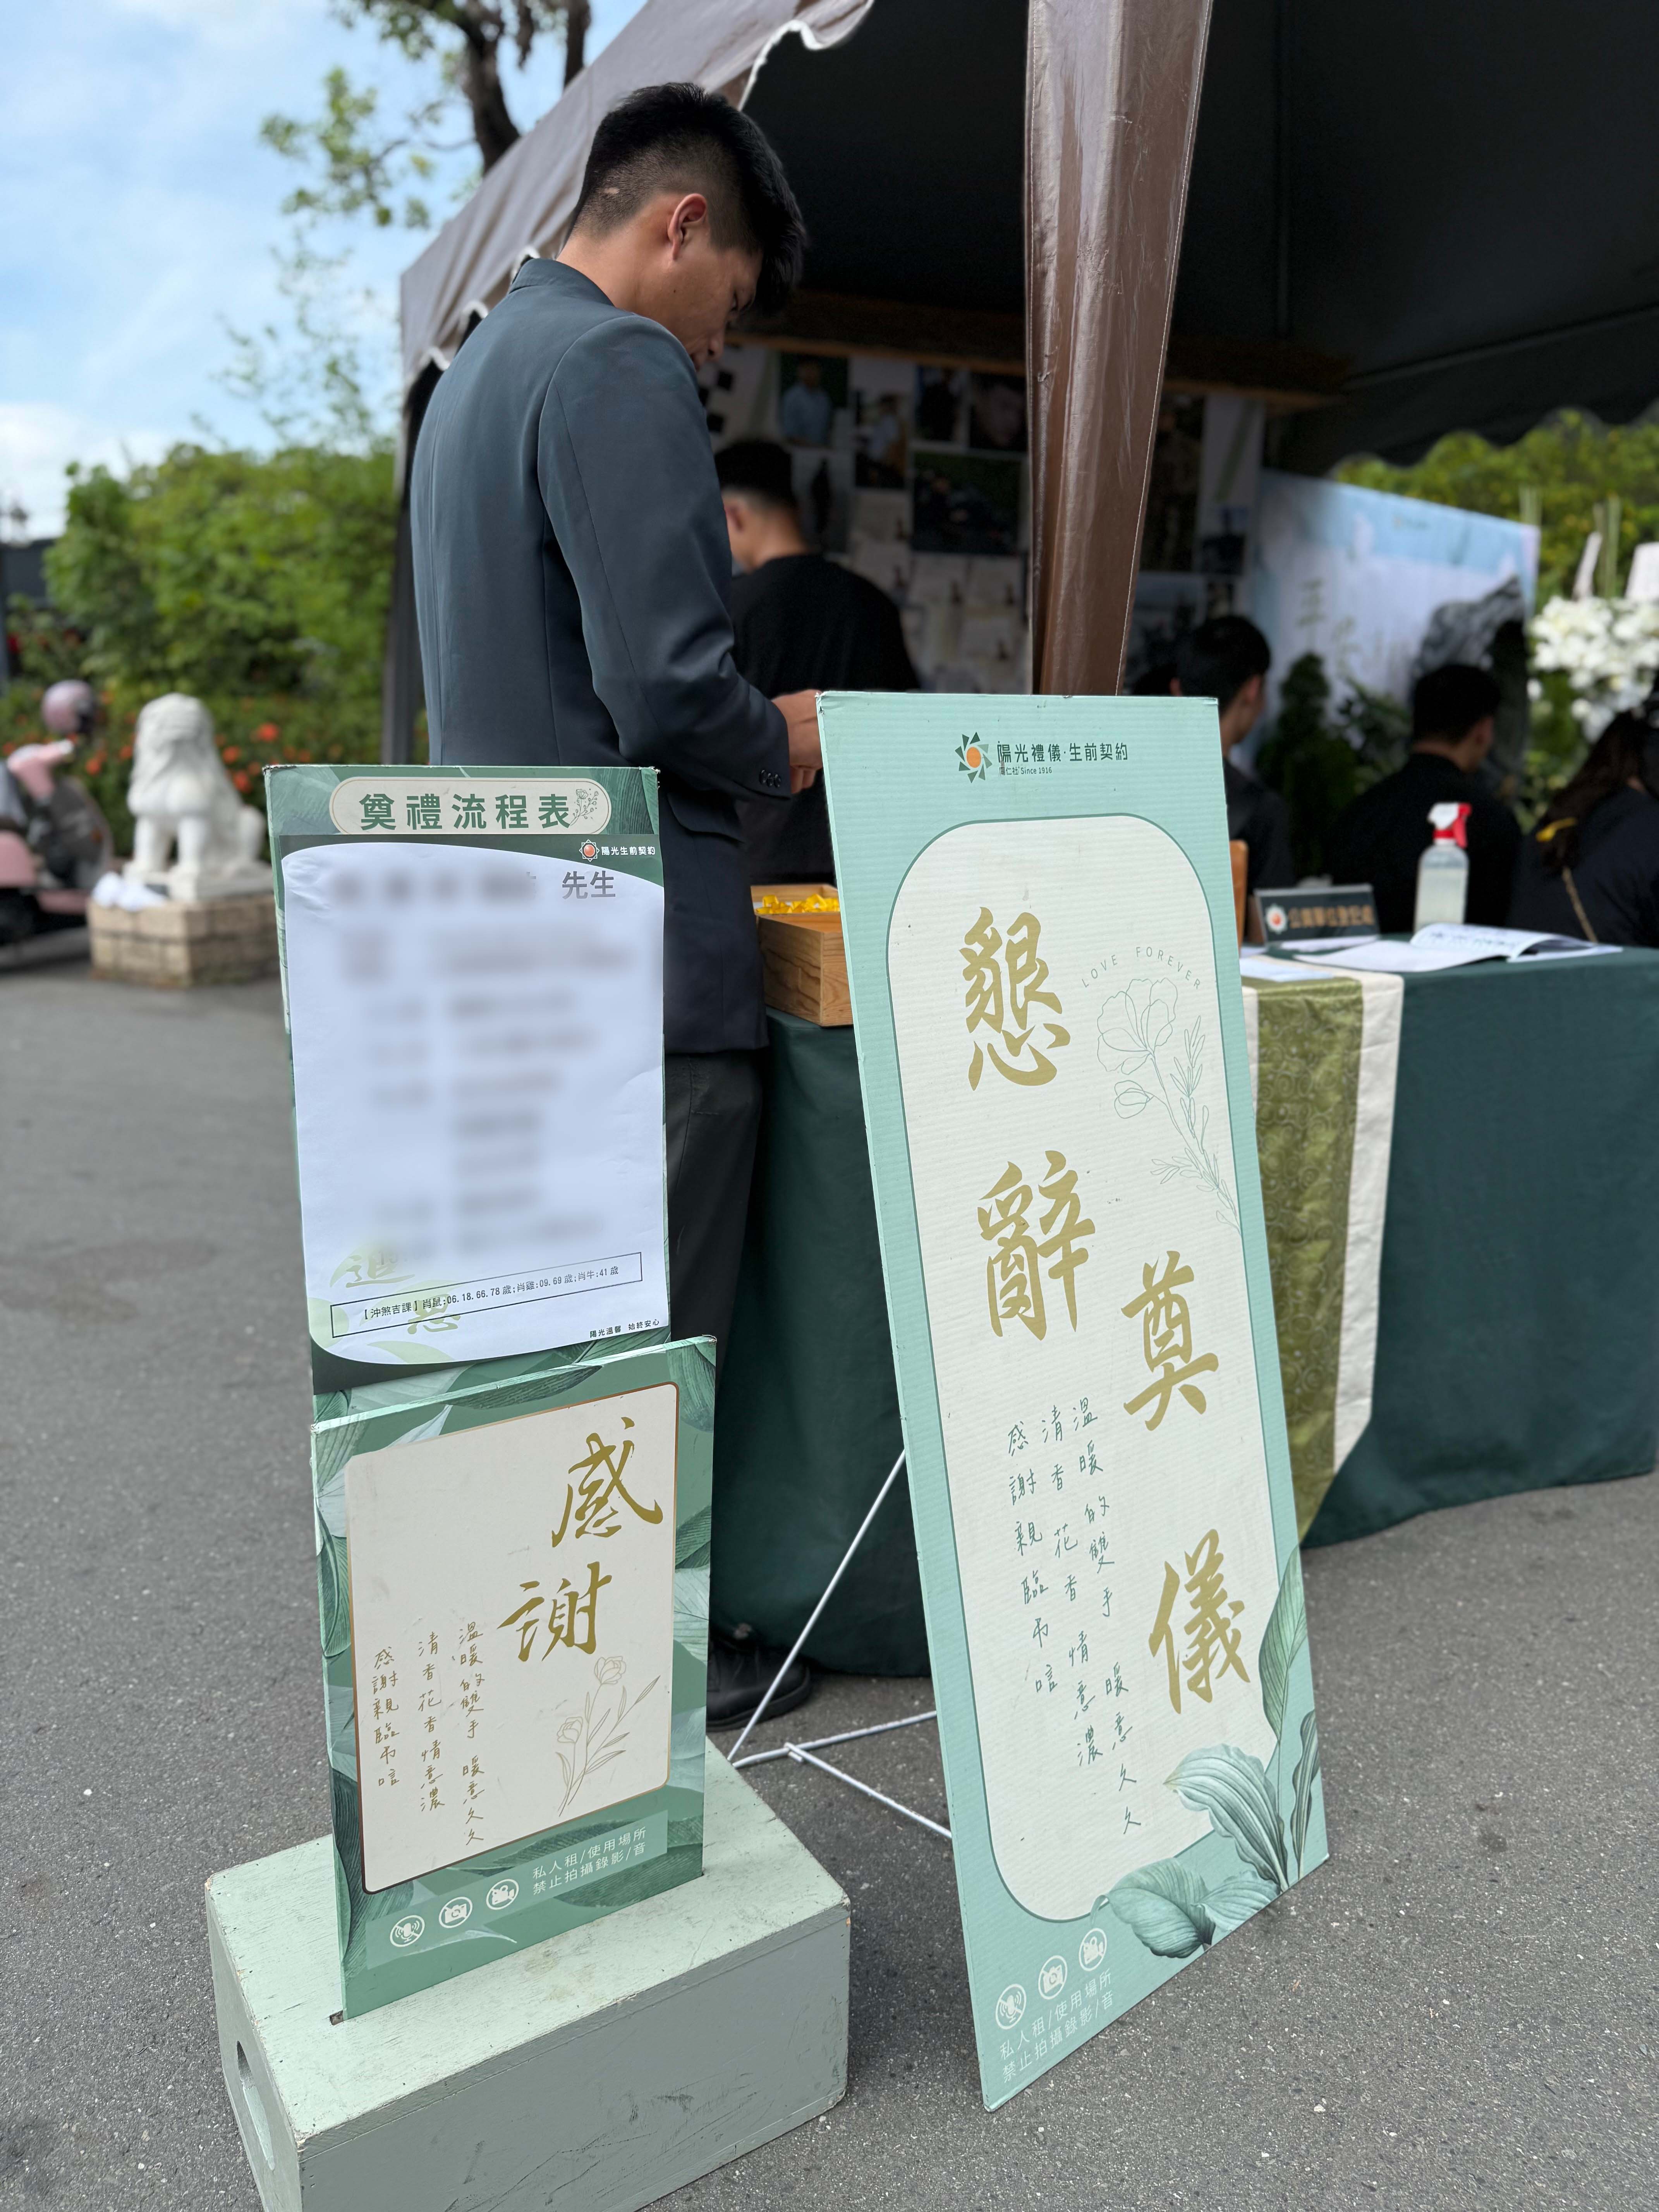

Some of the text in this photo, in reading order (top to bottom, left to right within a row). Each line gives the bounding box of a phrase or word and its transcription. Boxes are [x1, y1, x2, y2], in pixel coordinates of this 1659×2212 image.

[359, 793, 570, 830] 奠禮流程表
[601, 847, 655, 855] 陽光生前契約
[562, 871, 616, 900] 先生
[1082, 946, 1200, 990] LOVE FOREVER
[959, 907, 1251, 1714] 懇辭 奠儀
[496, 1416, 663, 1662] 感謝
[532, 1826, 647, 1879] 私人租/使用場所
[533, 1842, 646, 1896] 禁止拍攝錄影/音
[1000, 1968, 1111, 2060] 私人租/使用場所
[1003, 1990, 1113, 2083] 禁止拍攝錄影/音
